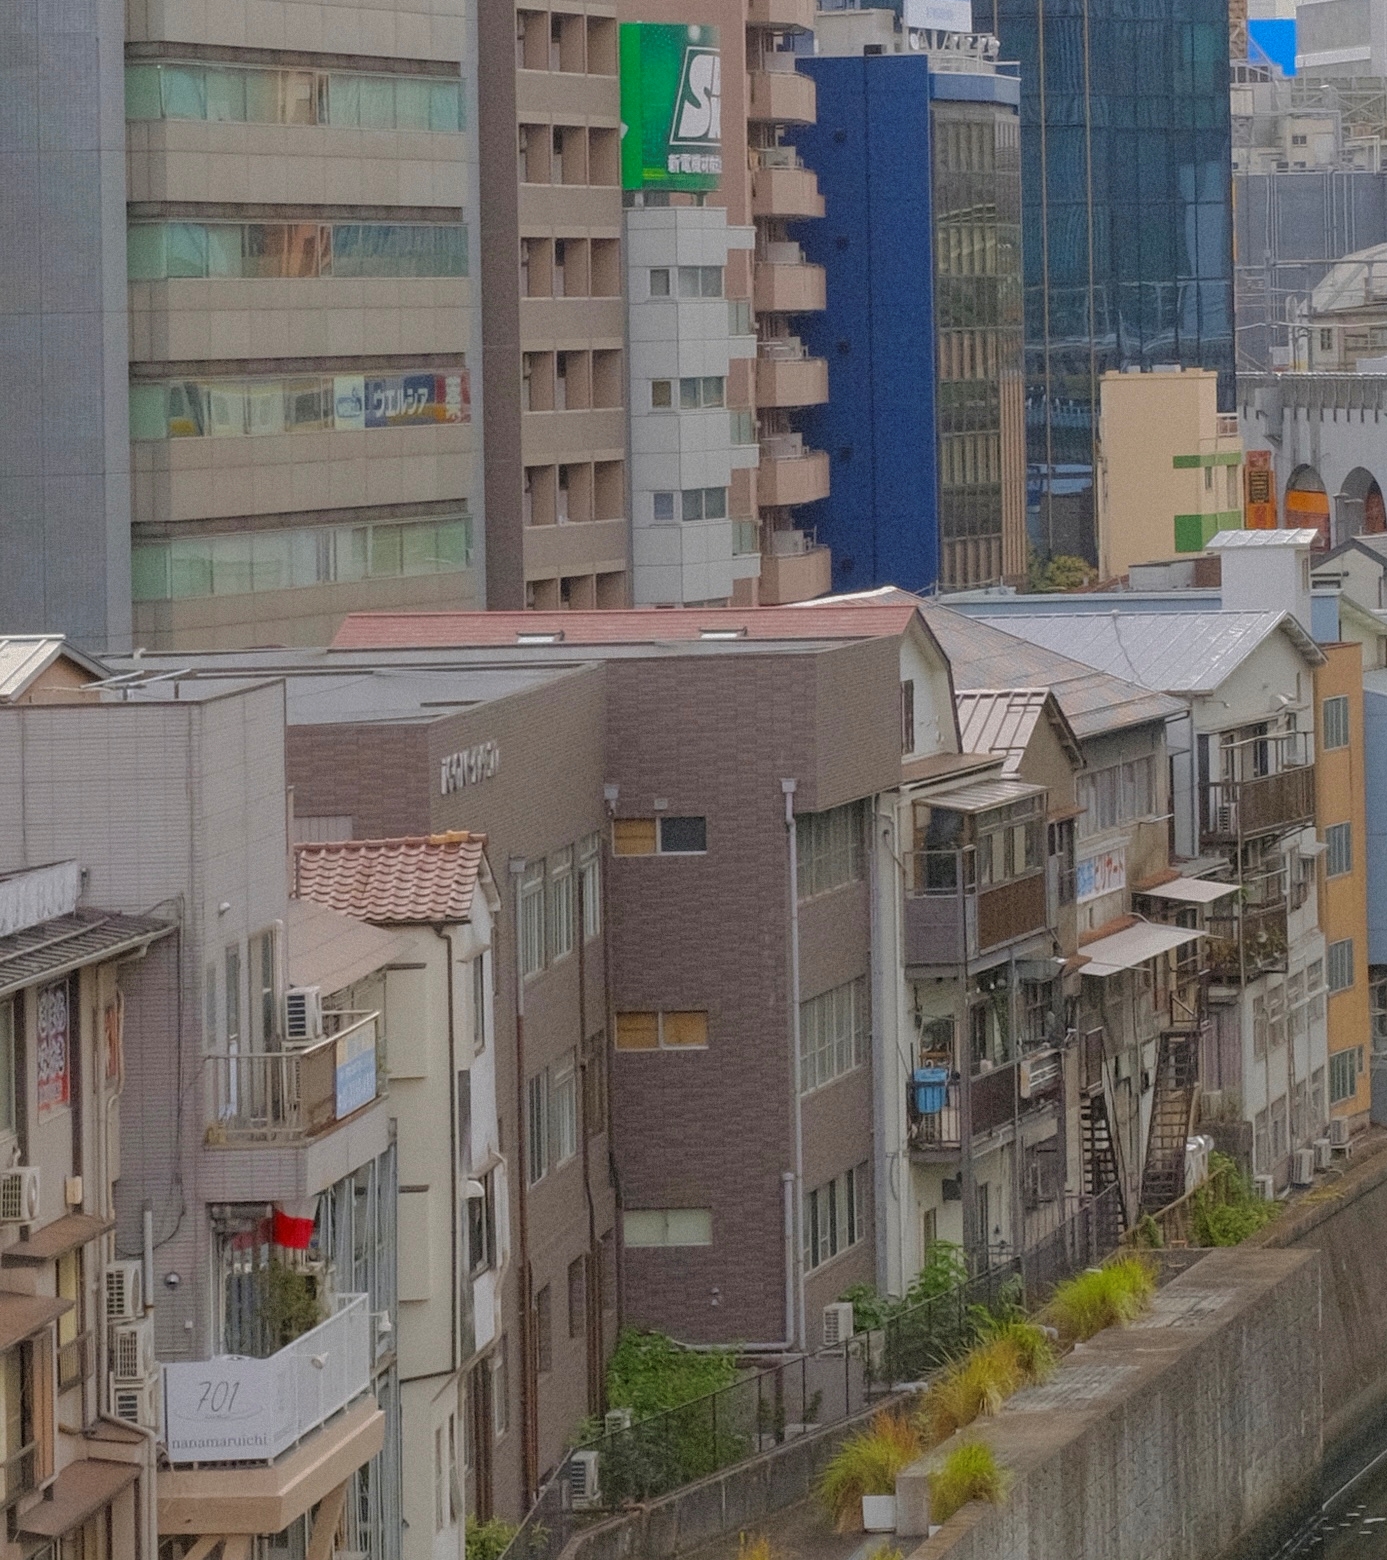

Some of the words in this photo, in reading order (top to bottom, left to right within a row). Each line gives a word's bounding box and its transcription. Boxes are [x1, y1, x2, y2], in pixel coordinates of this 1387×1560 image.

[374, 388, 429, 417] ウエルシア
[197, 1381, 240, 1413] 701
[171, 1432, 268, 1450] nanamaruichi
